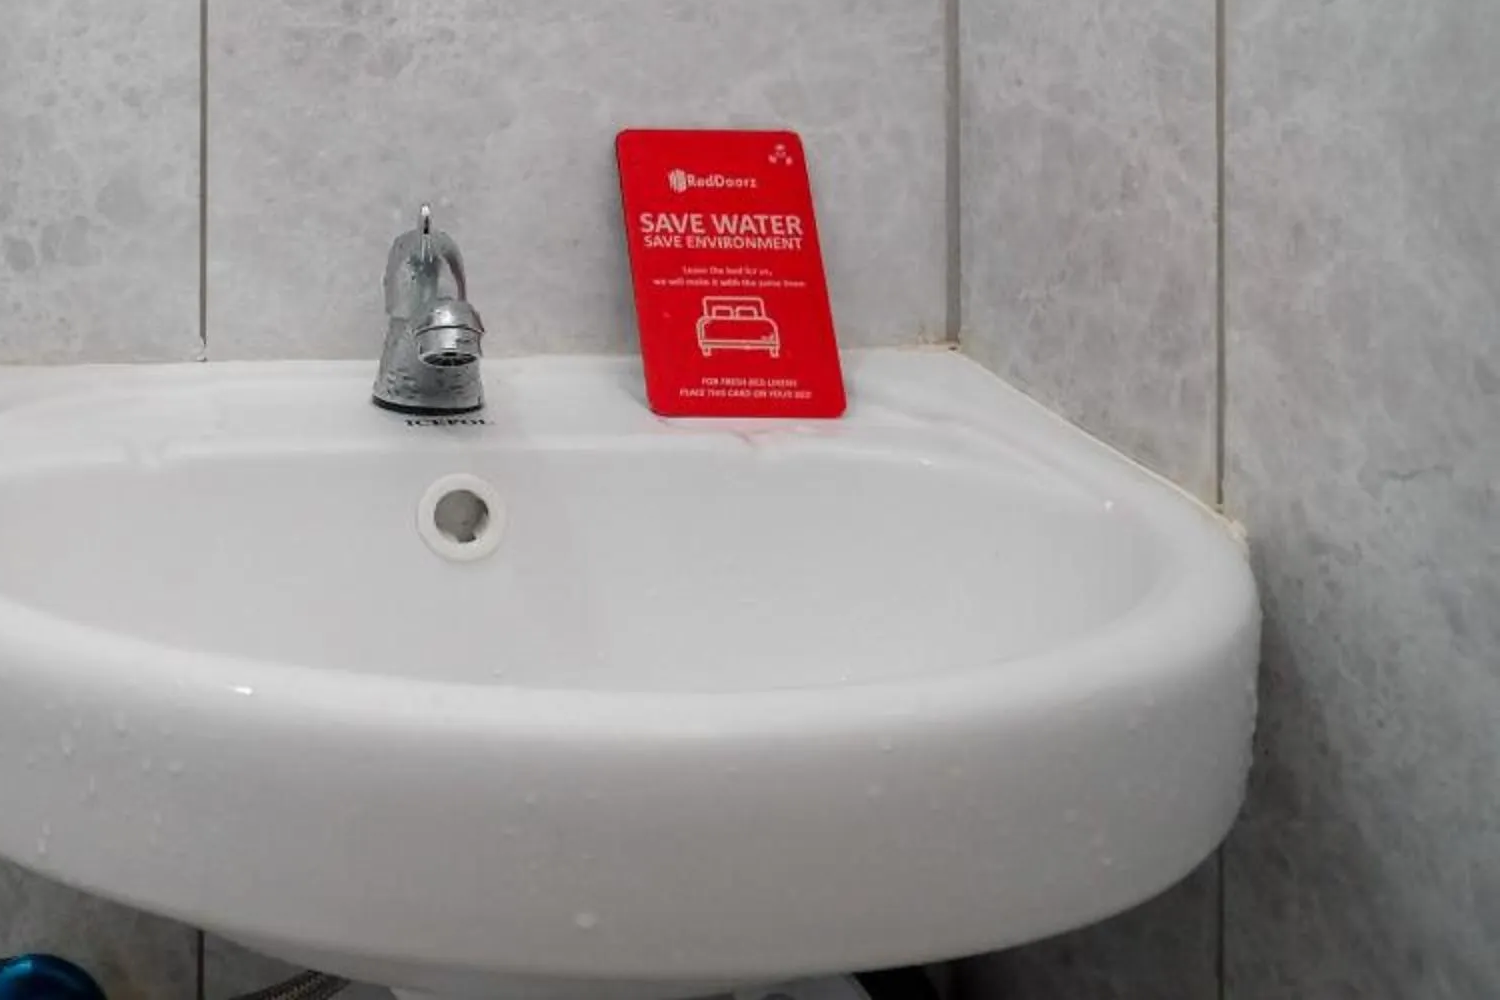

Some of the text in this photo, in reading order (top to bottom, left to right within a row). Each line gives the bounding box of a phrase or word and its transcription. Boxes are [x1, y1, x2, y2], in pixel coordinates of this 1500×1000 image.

[687, 173, 758, 189] RedDoorz
[639, 212, 803, 235] SAVE WATER
[643, 235, 803, 249] SAVE ENVIRONMENT
